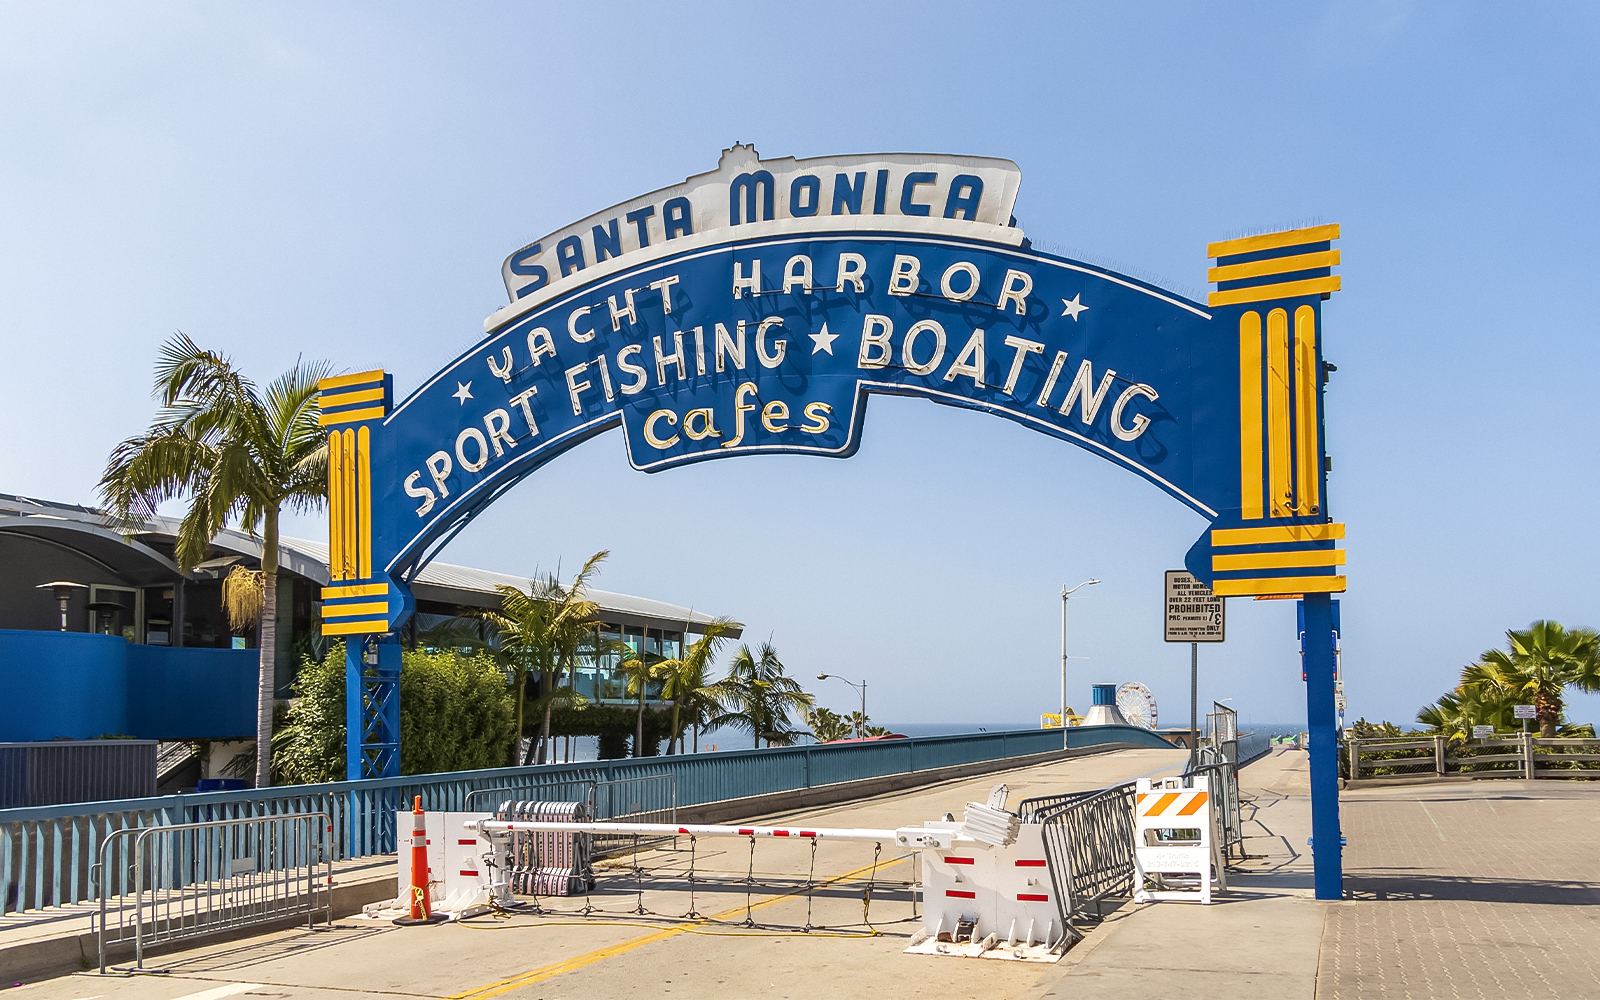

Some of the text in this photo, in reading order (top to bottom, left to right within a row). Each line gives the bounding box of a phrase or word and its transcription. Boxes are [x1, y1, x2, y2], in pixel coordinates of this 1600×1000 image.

[509, 169, 985, 299] SANTA MONICA
[487, 252, 1034, 384] YACHT HARBOR
[403, 313, 1160, 518] SPORT FISHING BOATING
[643, 381, 834, 449] cafes
[1169, 604, 1221, 613] PROHIBITED
